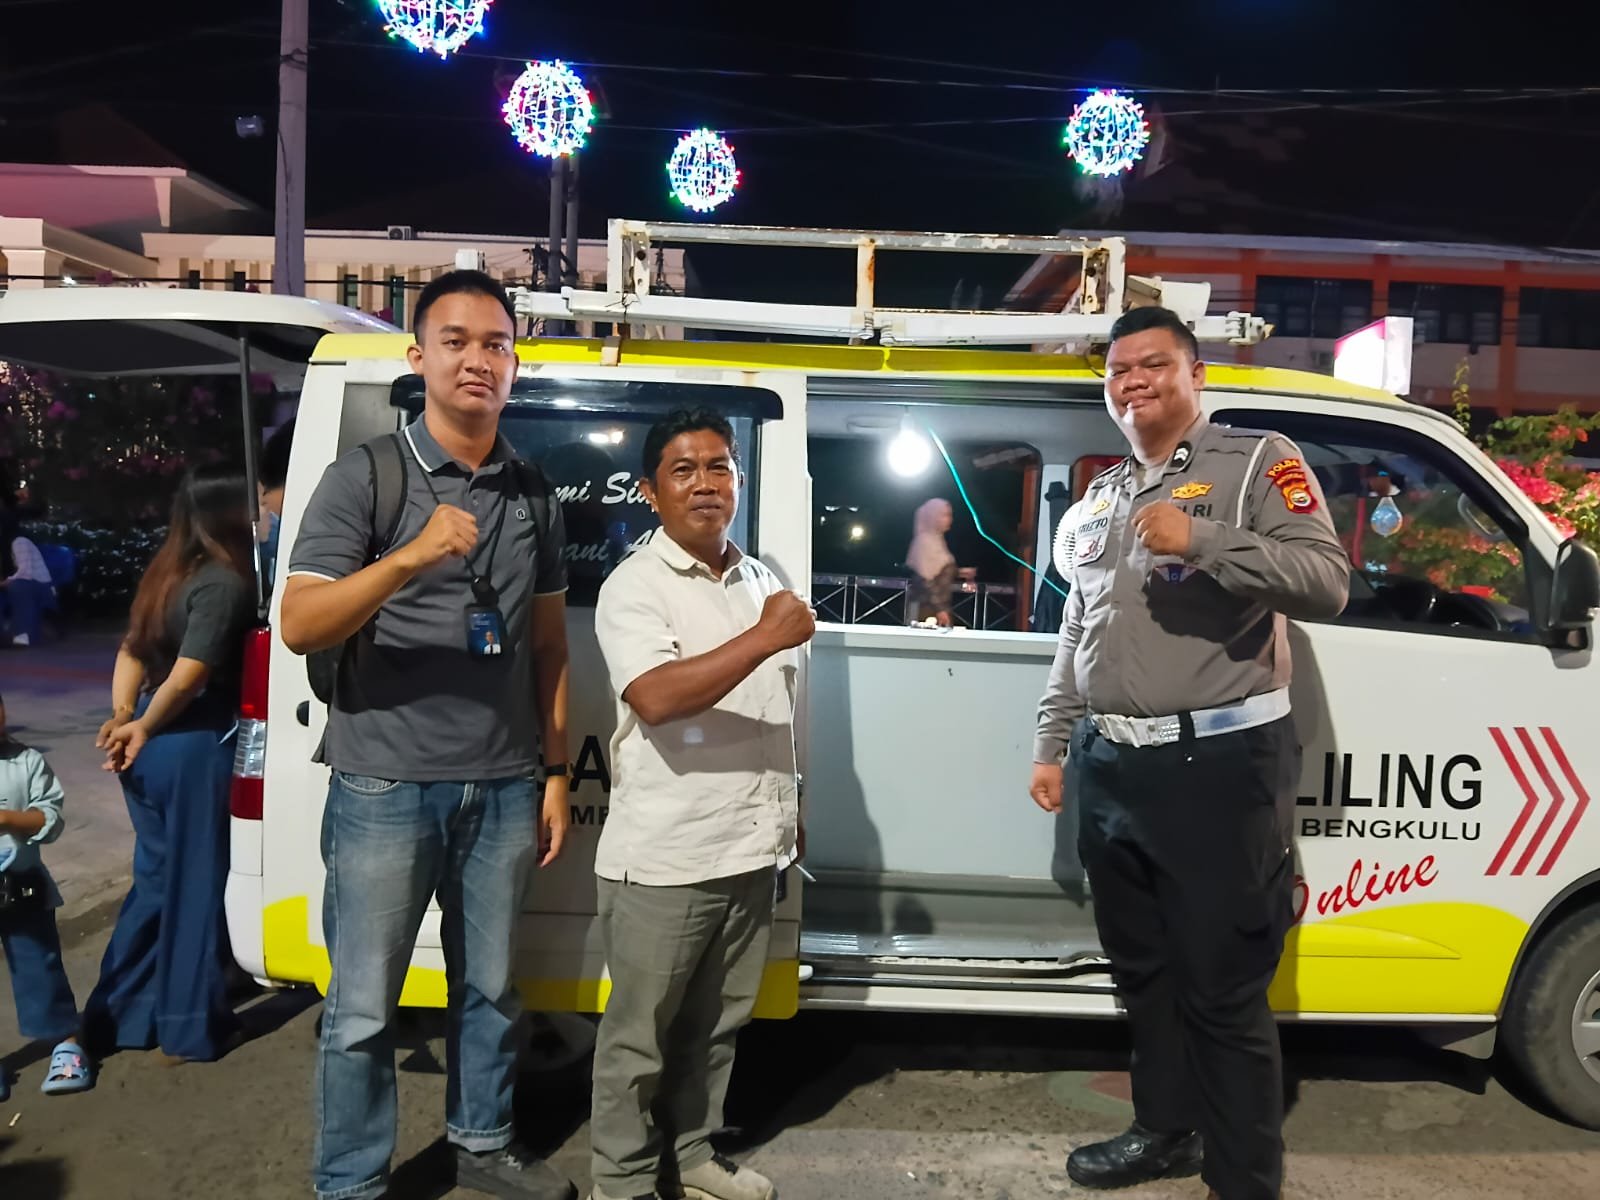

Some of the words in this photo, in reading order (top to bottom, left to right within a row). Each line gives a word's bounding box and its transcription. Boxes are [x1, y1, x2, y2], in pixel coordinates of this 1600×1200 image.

[1267, 459, 1301, 477] POLDA
[554, 480, 591, 503] mi
[601, 471, 655, 512] Si
[563, 538, 610, 562] ani
[617, 529, 653, 564] A
[1301, 818, 1481, 841] BENGKULU
